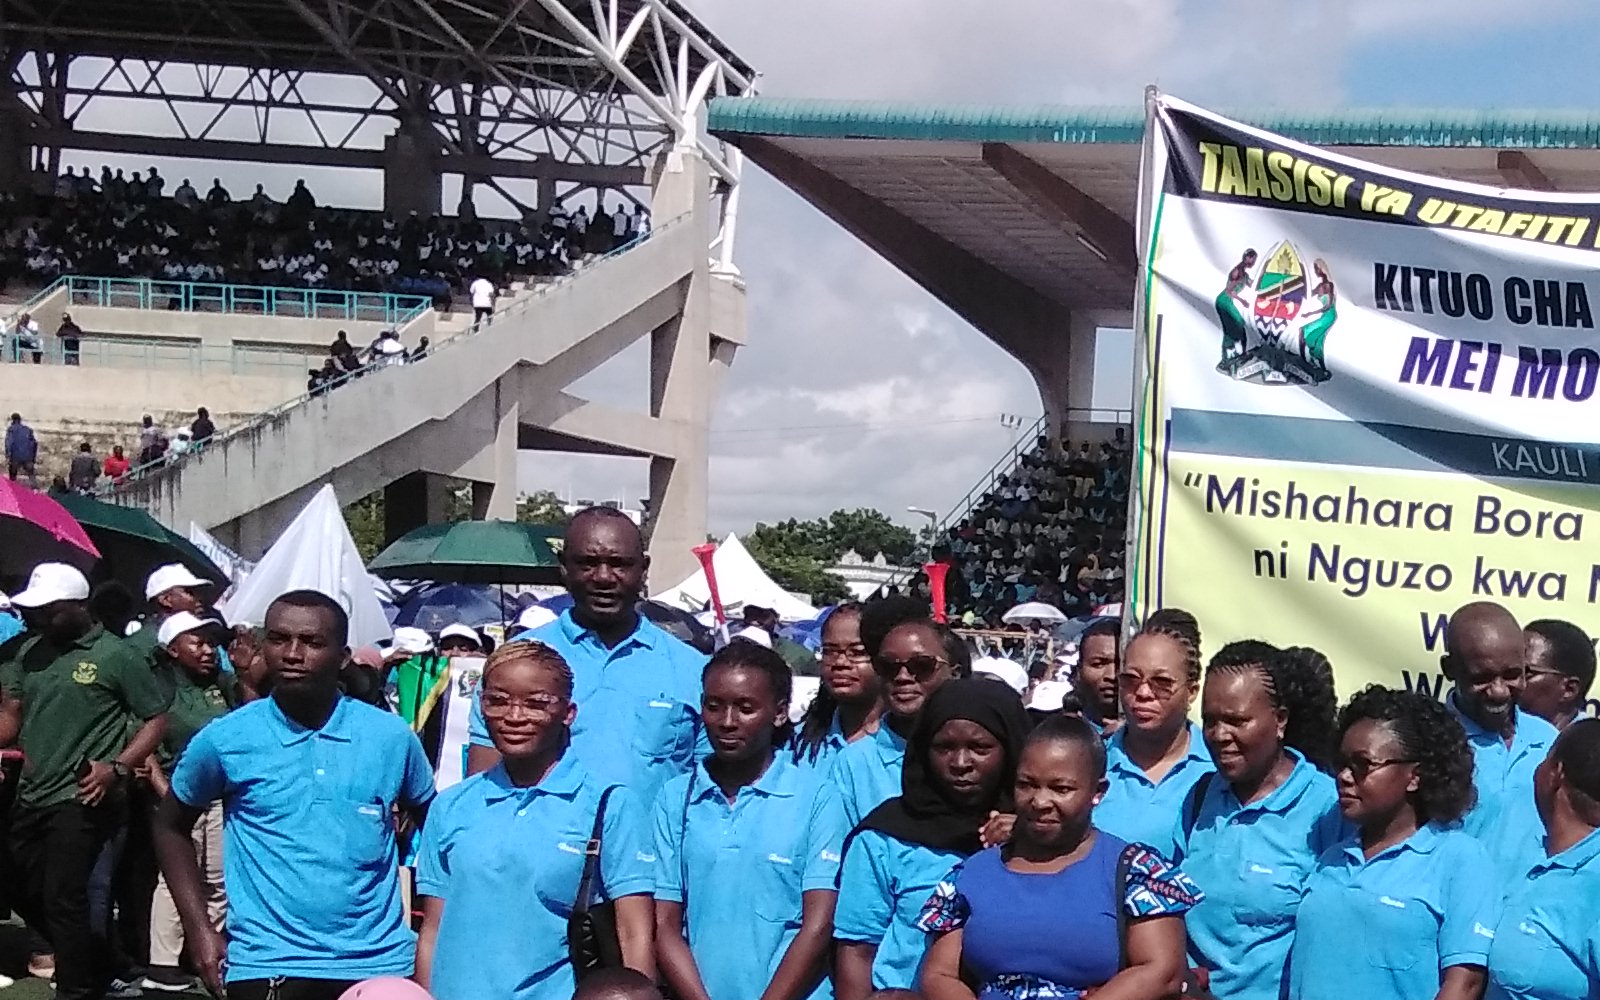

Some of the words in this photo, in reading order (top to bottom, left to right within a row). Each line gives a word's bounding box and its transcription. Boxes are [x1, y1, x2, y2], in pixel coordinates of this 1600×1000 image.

[1199, 142, 1355, 208] TAASISI
[1361, 181, 1412, 215] YA
[1417, 197, 1590, 246] UTAFITI
[1373, 262, 1493, 319] KITUO
[1504, 276, 1595, 329] CHA
[1398, 336, 1502, 394] MEI
[1490, 442, 1588, 478] KAULI
[1474, 495, 1584, 541] Bora
[1253, 539, 1289, 579] ni
[1308, 542, 1453, 597] Nguzo
[1472, 555, 1568, 602] kwa
